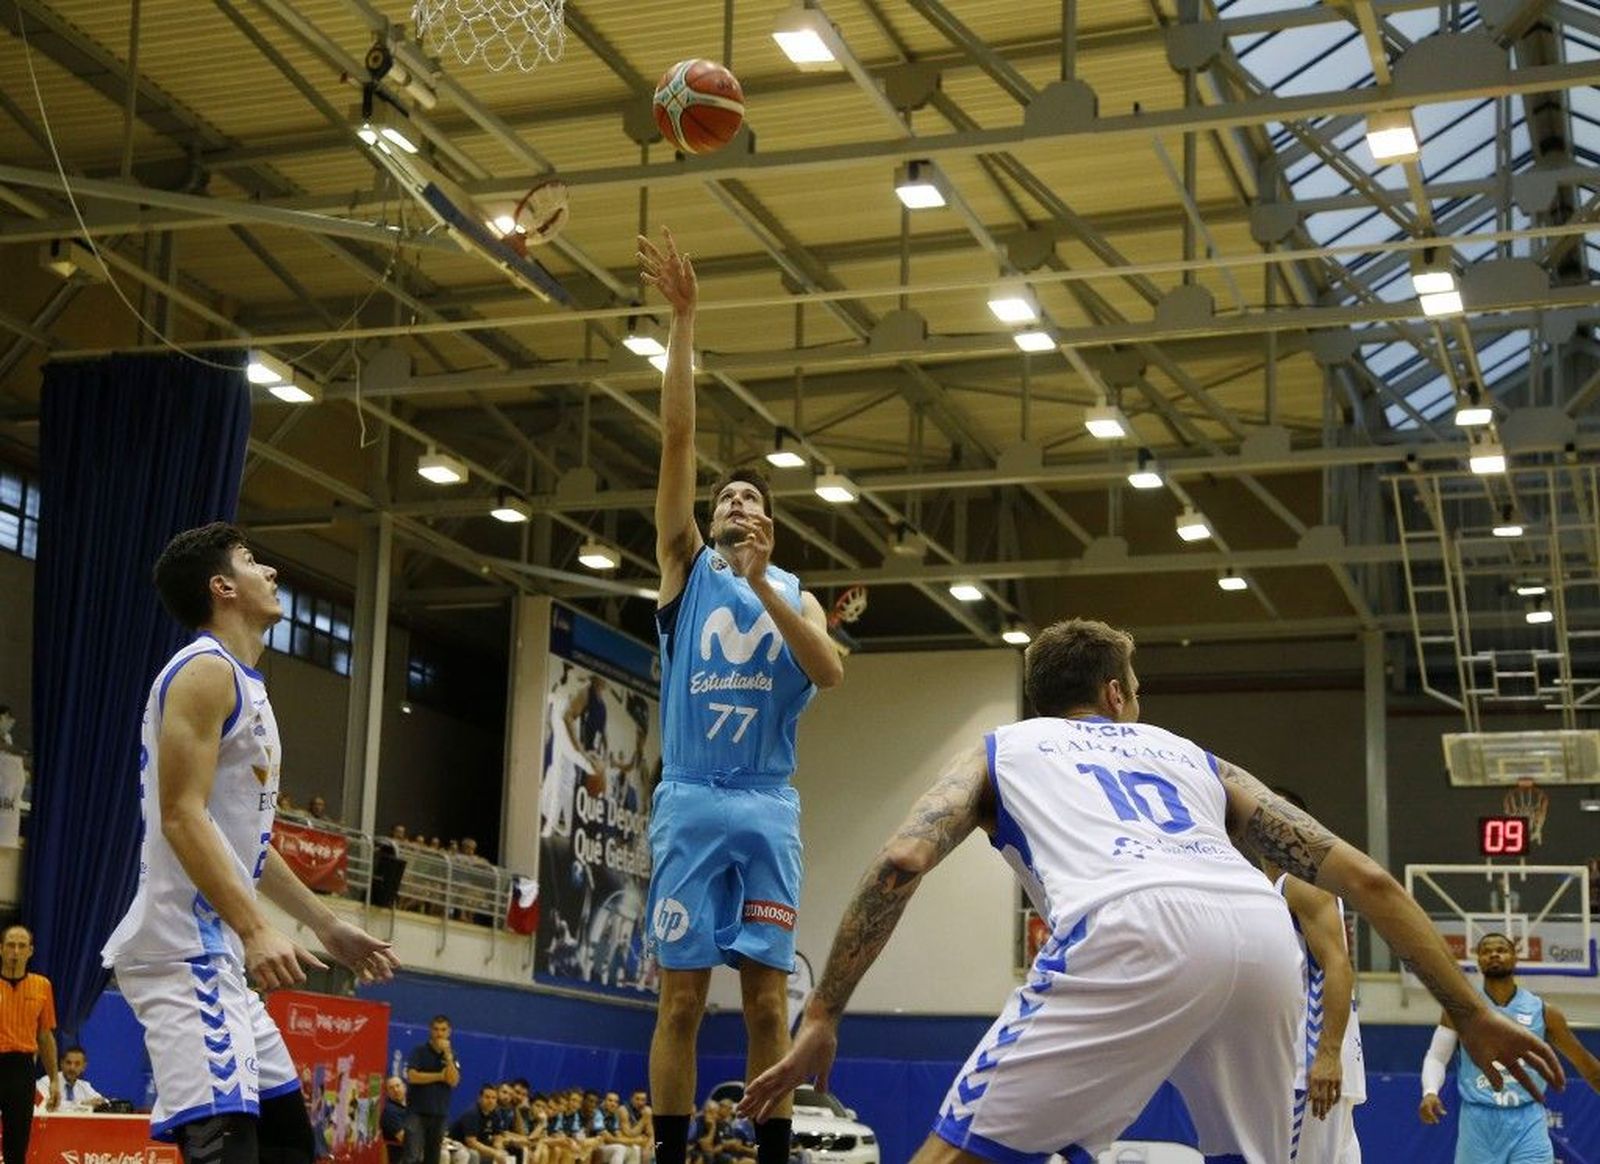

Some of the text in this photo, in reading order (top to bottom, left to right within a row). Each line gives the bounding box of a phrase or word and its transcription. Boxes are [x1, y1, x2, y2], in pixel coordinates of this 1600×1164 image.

[690, 671, 773, 694] Estudiantes
[706, 702, 759, 743] 77
[577, 786, 604, 824] Qué
[1076, 763, 1197, 834] 10
[574, 828, 603, 866] Qué
[1485, 820, 1523, 852] 09
